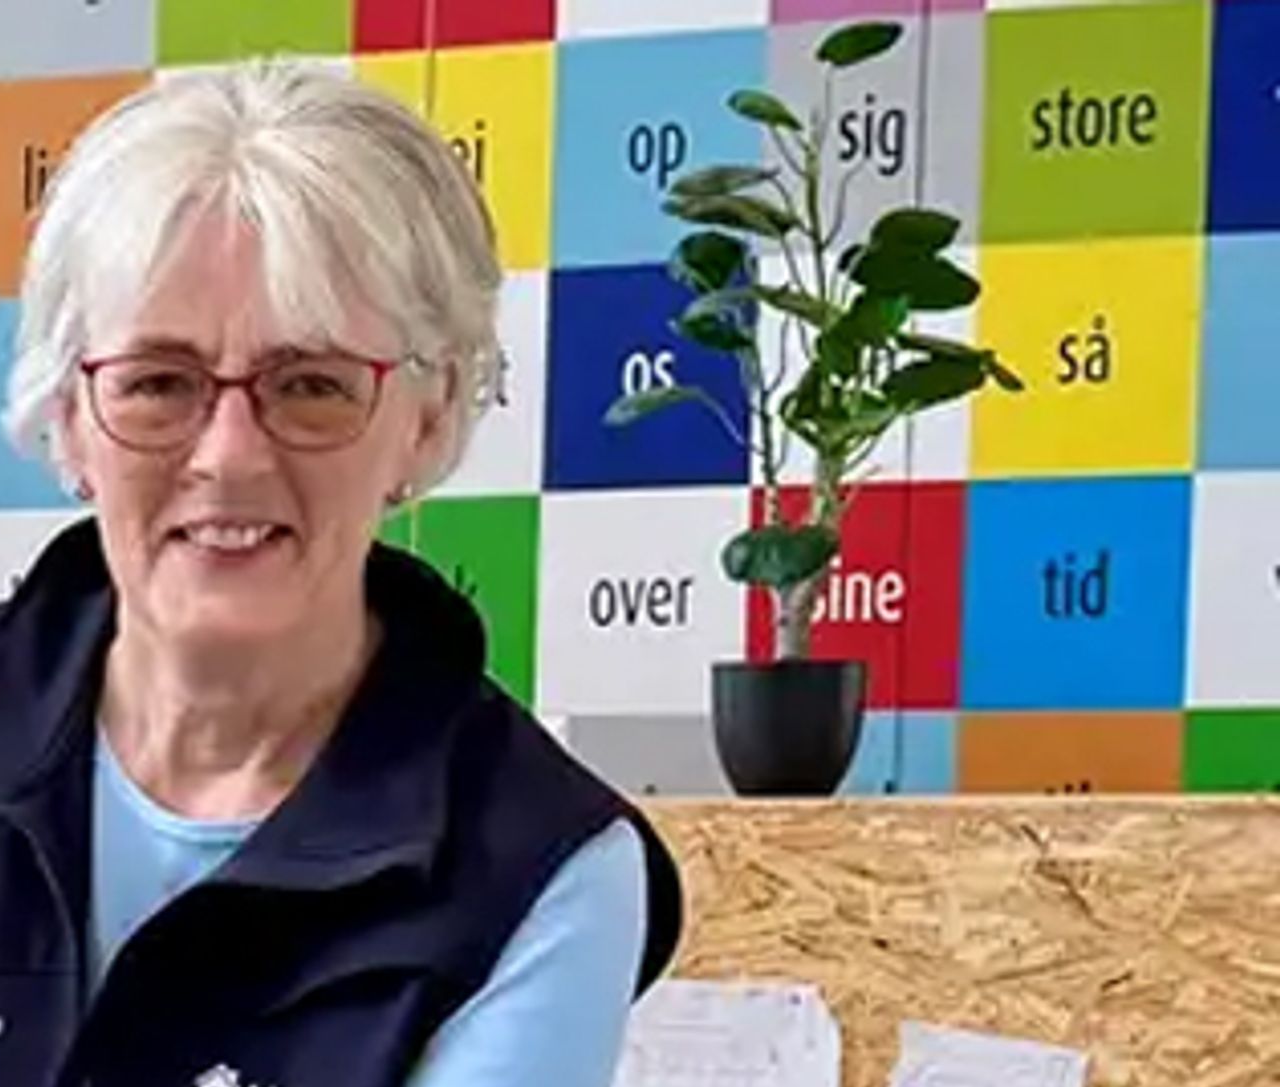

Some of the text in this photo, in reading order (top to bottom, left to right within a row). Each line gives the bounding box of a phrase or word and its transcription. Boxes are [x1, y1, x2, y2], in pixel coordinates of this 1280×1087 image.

[839, 94, 906, 176] sig
[1033, 88, 1156, 150] store
[629, 123, 686, 188] op
[624, 352, 675, 393] os
[1058, 316, 1110, 384] så
[590, 578, 692, 627] over
[1044, 550, 1109, 618] tid
